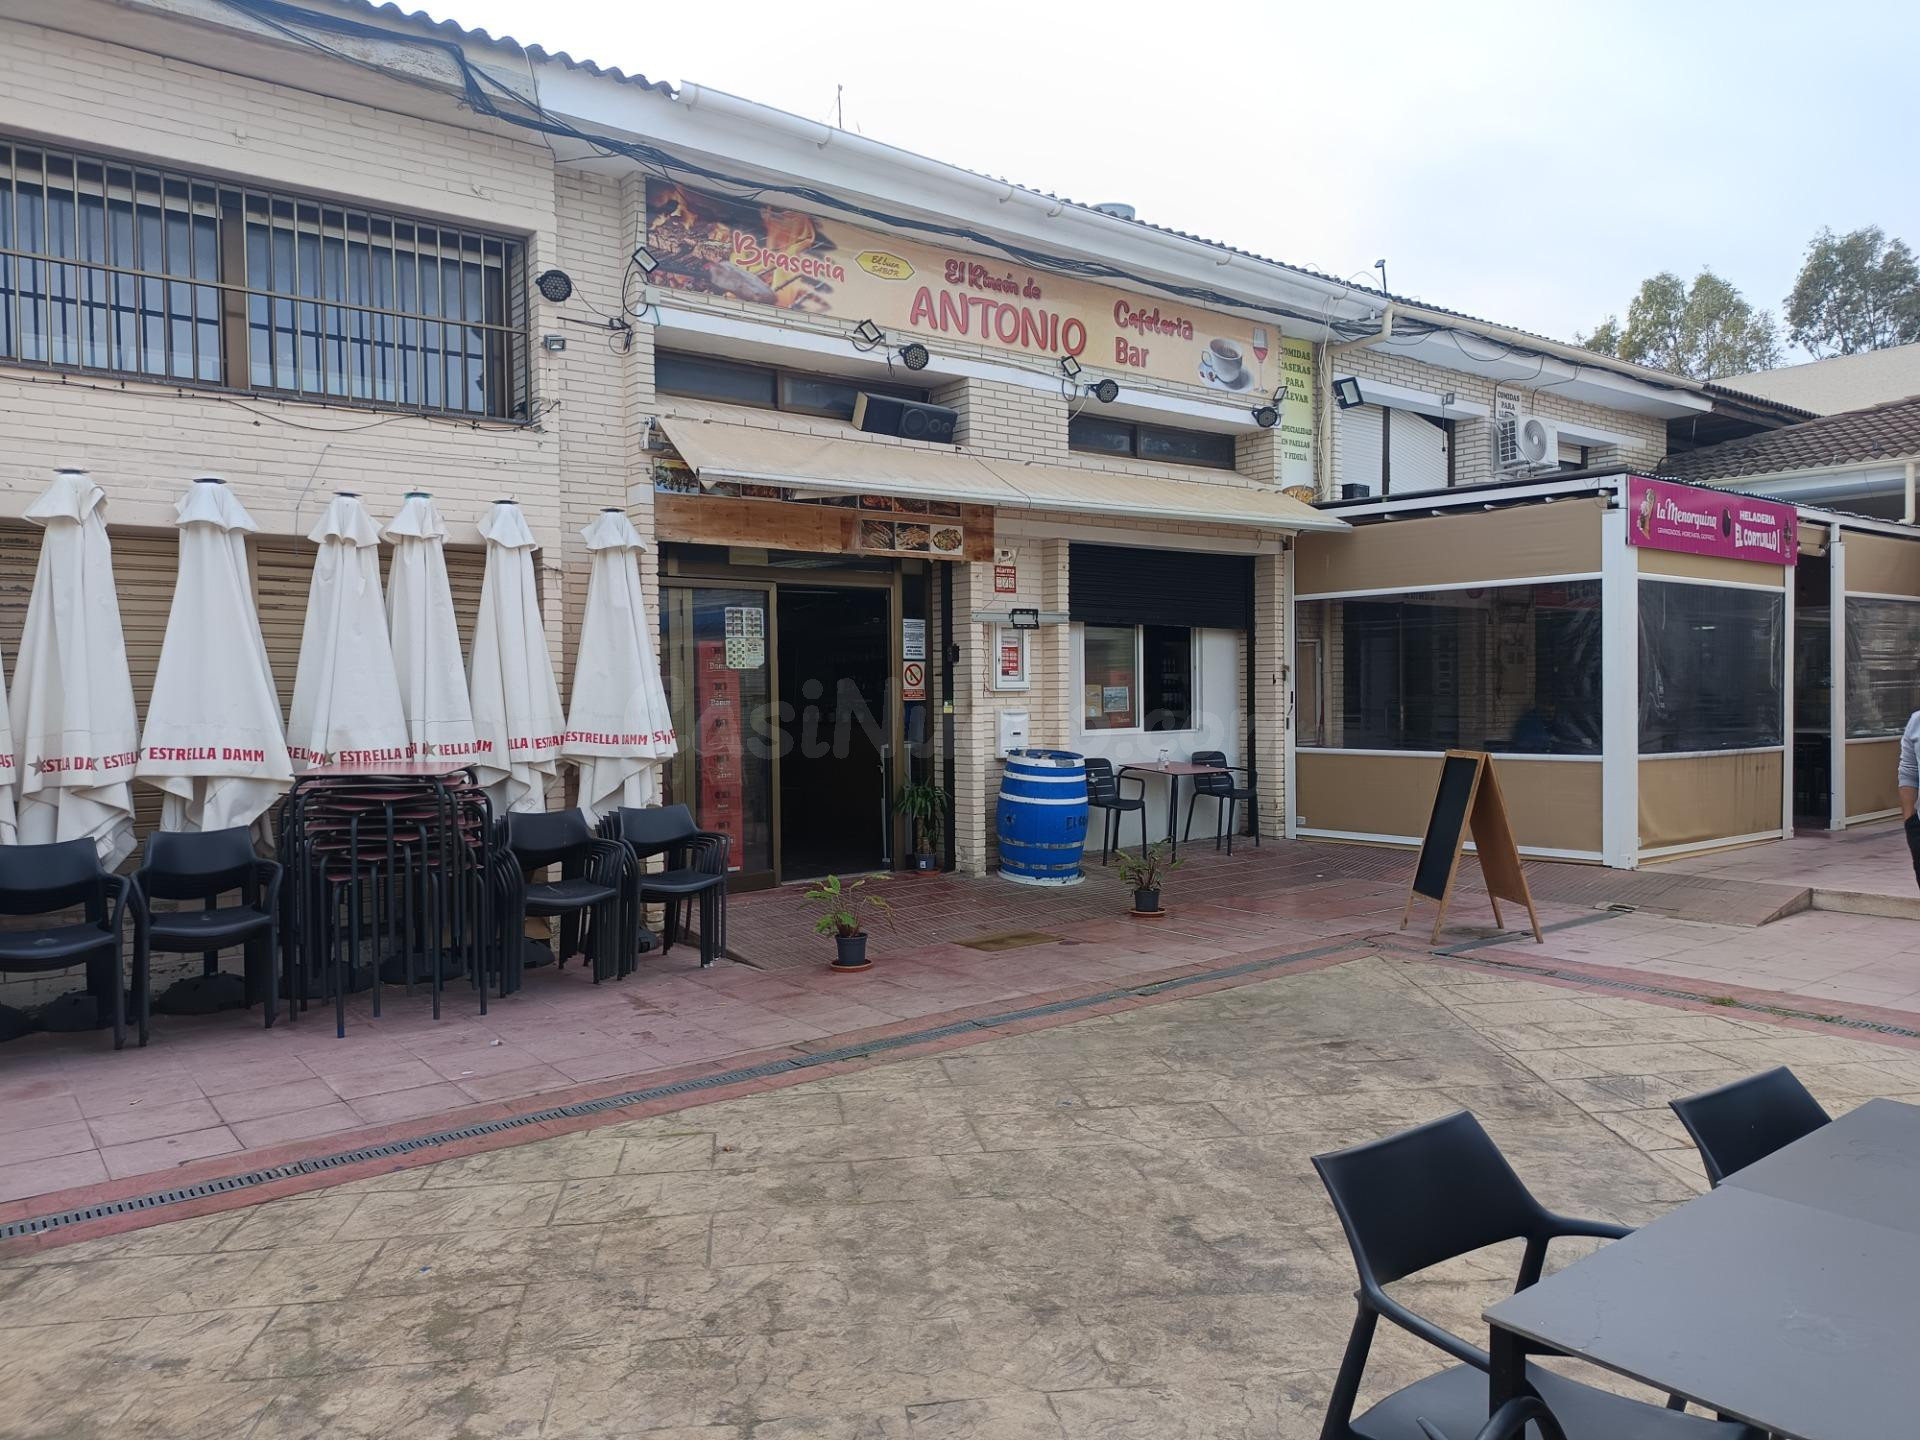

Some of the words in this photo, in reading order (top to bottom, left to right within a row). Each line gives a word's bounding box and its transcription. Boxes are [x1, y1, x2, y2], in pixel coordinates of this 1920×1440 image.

[733, 231, 845, 283] Braseria
[944, 259, 965, 284] El
[968, 262, 1020, 296] Rincón
[1022, 276, 1041, 300] de
[909, 286, 1087, 357] ANTONIO
[1115, 336, 1150, 368] Bar
[1285, 376, 1305, 389] PARA
[1657, 503, 1666, 519] La
[1665, 498, 1717, 530] Menorquina
[564, 730, 620, 745] ESTRELLA
[149, 747, 217, 761] ESTRELLA
[222, 747, 265, 762] DAMM
[339, 747, 402, 763] ESTRELLA
